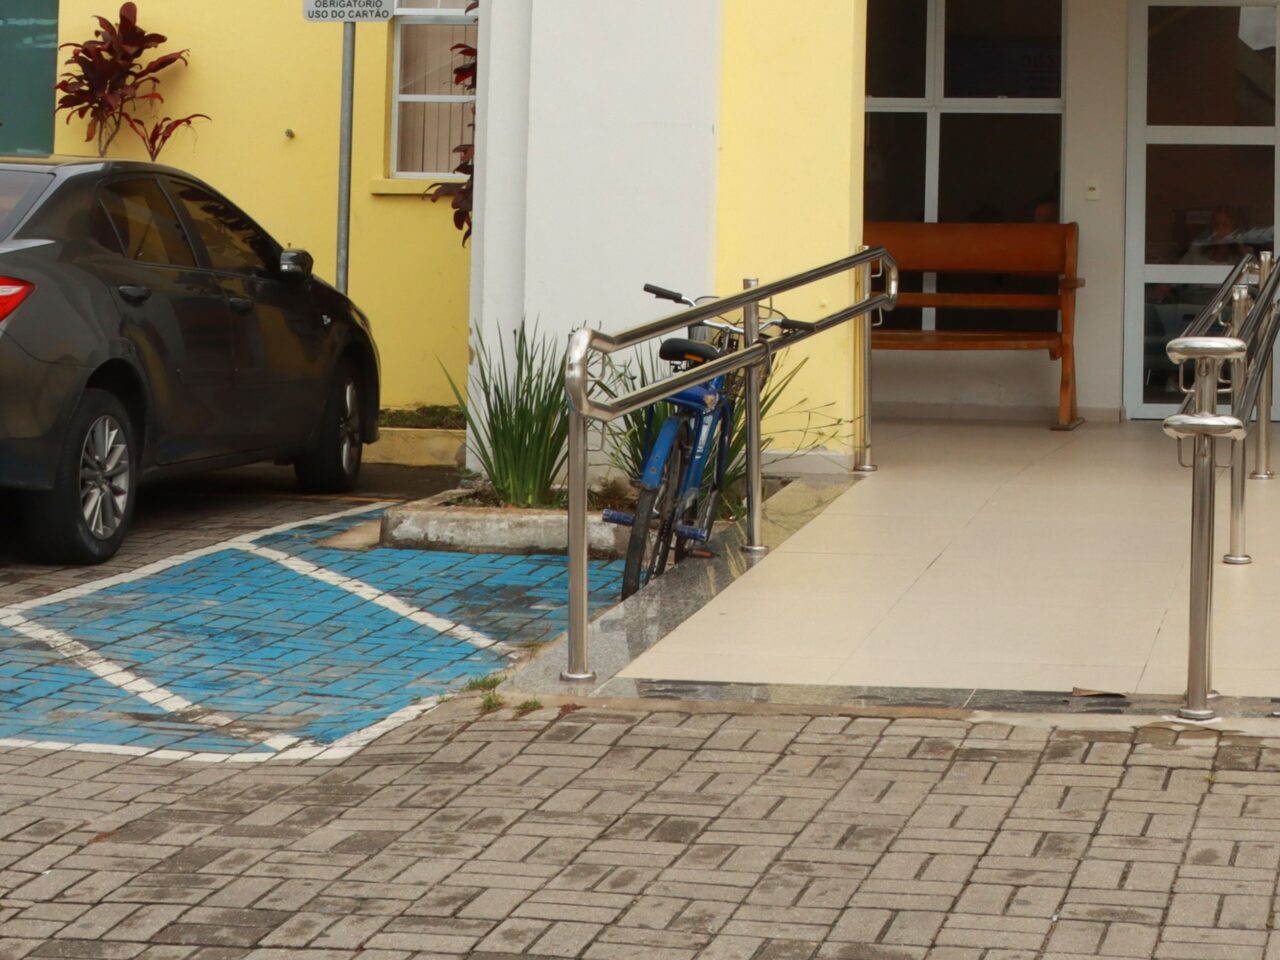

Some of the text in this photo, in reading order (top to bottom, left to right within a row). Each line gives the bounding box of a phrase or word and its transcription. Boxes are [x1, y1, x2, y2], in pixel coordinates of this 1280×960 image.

[308, 8, 390, 18] USO DO CARTÃO
